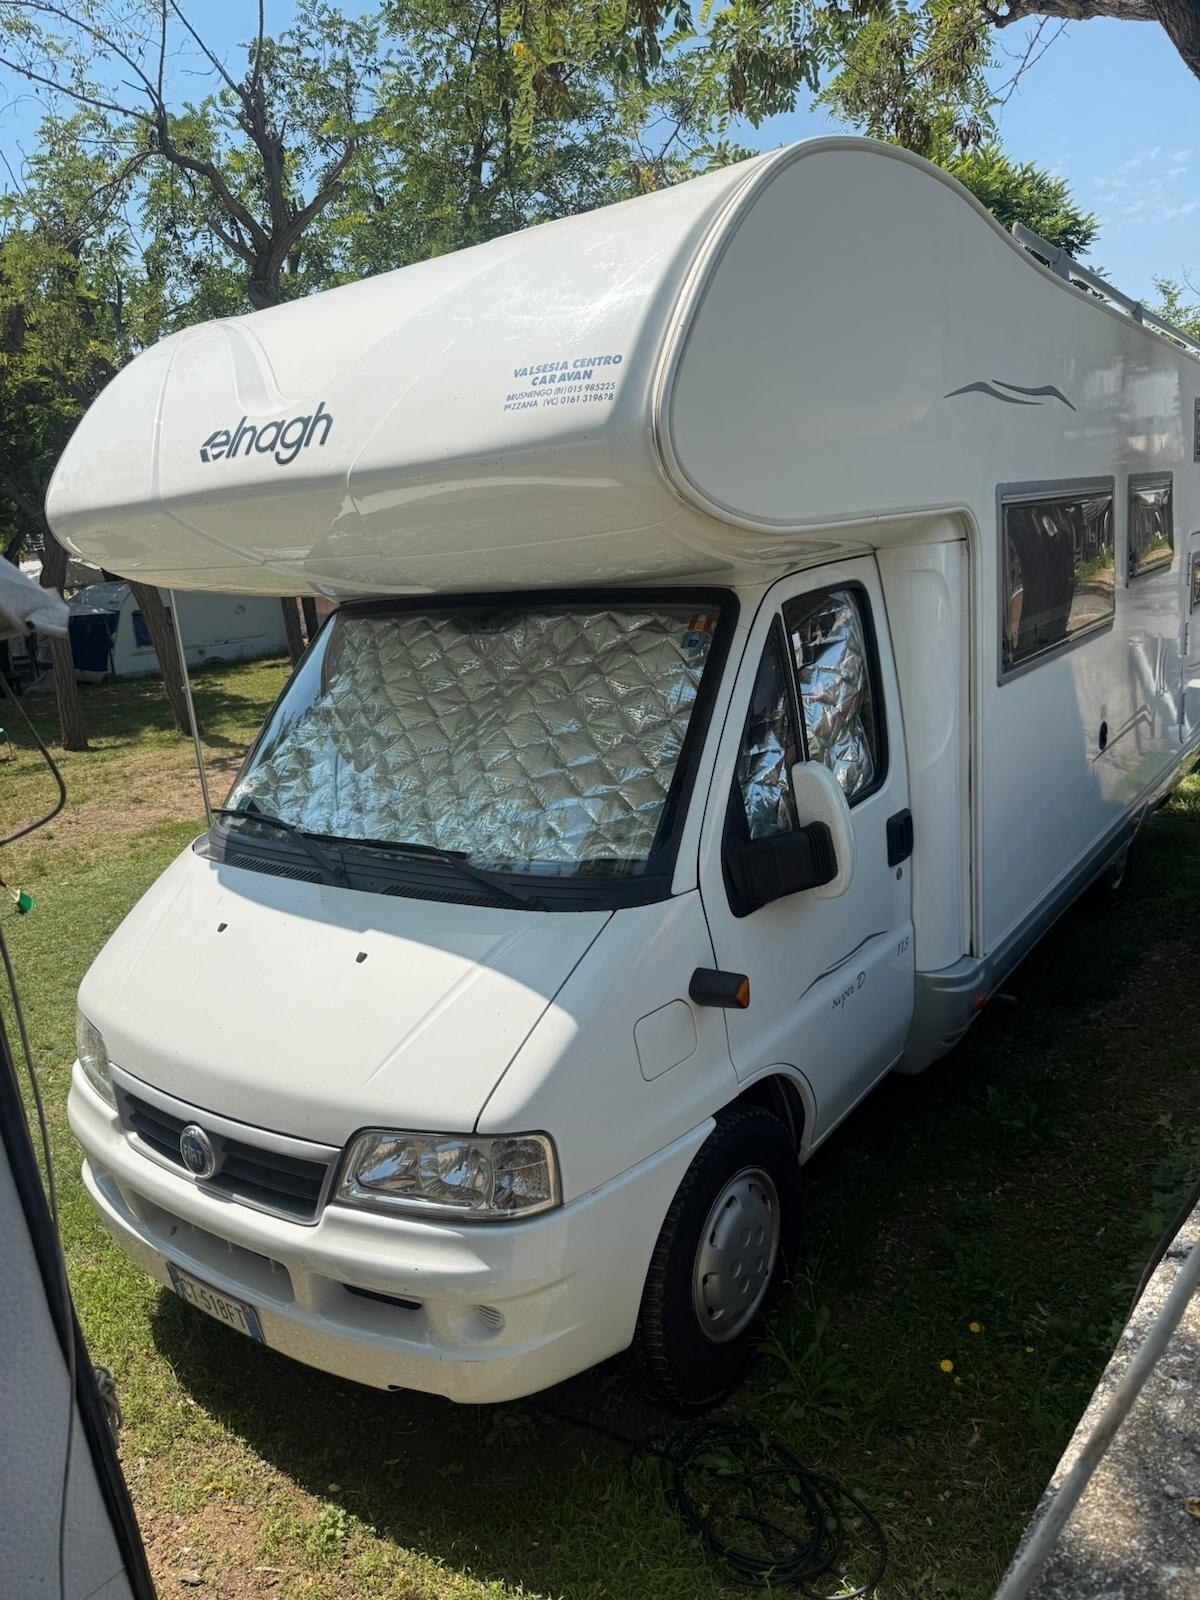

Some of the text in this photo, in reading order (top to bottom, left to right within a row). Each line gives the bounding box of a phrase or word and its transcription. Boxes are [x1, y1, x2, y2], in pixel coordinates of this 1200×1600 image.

[513, 354, 623, 378] VALSESIA CENTRO
[531, 369, 593, 386] CARAVAN
[506, 388, 552, 401] BRUSNENGO
[567, 384, 582, 393] 015
[585, 382, 616, 391] 985225
[560, 395, 580, 405] 0161
[199, 401, 334, 465] elnagh
